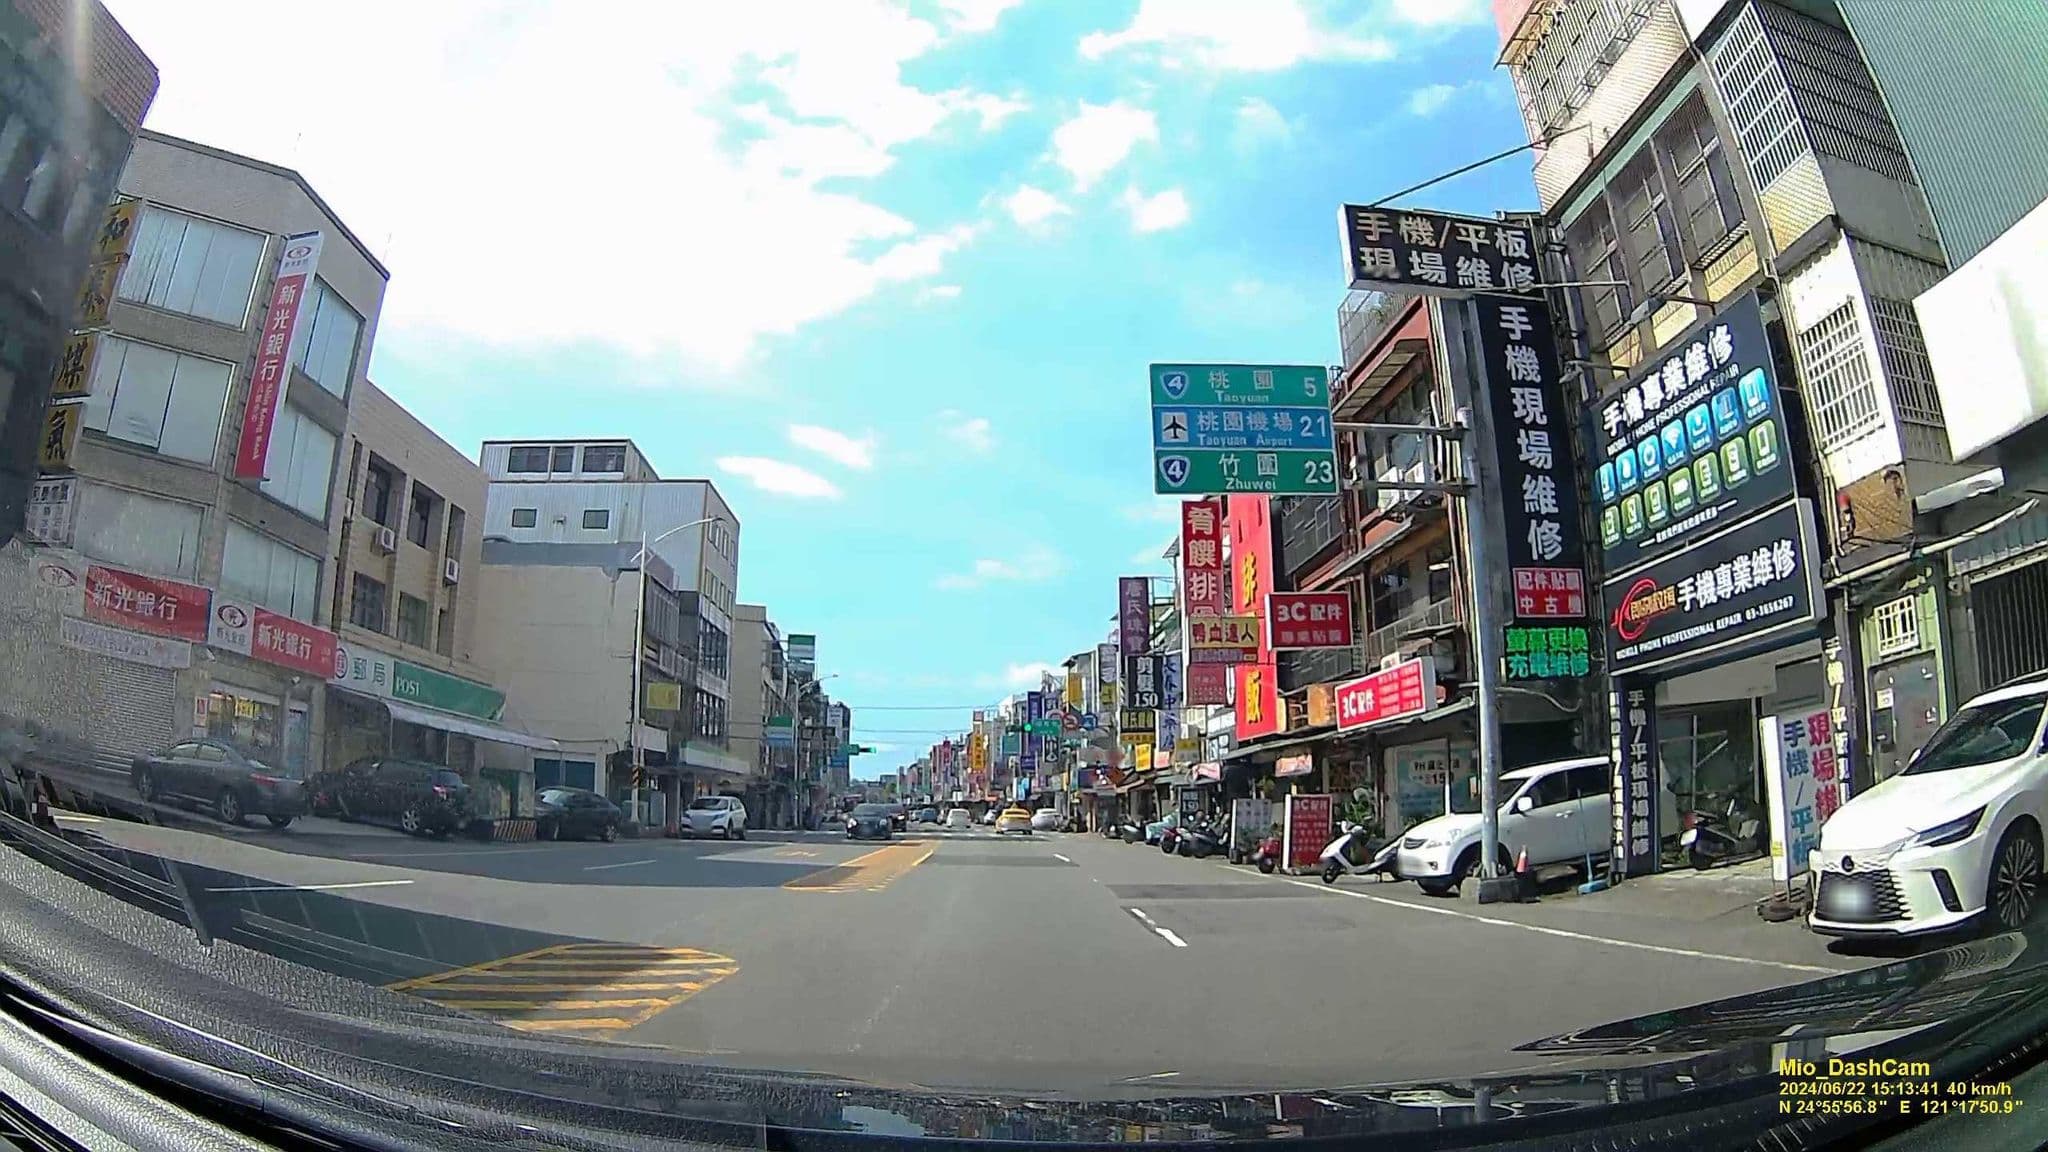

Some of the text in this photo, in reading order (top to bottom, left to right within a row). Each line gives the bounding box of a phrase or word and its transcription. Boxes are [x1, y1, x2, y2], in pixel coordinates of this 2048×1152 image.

[1356, 212, 1530, 260] 手機/平板
[1359, 247, 1536, 293] 現場維修
[260, 284, 297, 381] 新光銀行
[1167, 375, 1182, 391] 4
[1208, 369, 1318, 397] 桃園 5
[1214, 390, 1269, 404] Taoyuan
[1196, 411, 1327, 438] 桃園機場 21
[1500, 306, 1562, 561] 手機現場維修
[1196, 433, 1293, 447] Taoyuan Airport
[1167, 462, 1183, 479] 4
[1225, 478, 1277, 491] Zhuwei
[1304, 460, 1334, 484] 23
[1677, 539, 1796, 611] 手機專業維修
[93, 582, 178, 620] 新光銀行
[257, 623, 312, 660] 新光銀行
[353, 657, 385, 686] 郵局
[396, 676, 419, 697] POST
[1134, 693, 1158, 707] 150
[1784, 720, 1816, 866] 手機/平板
